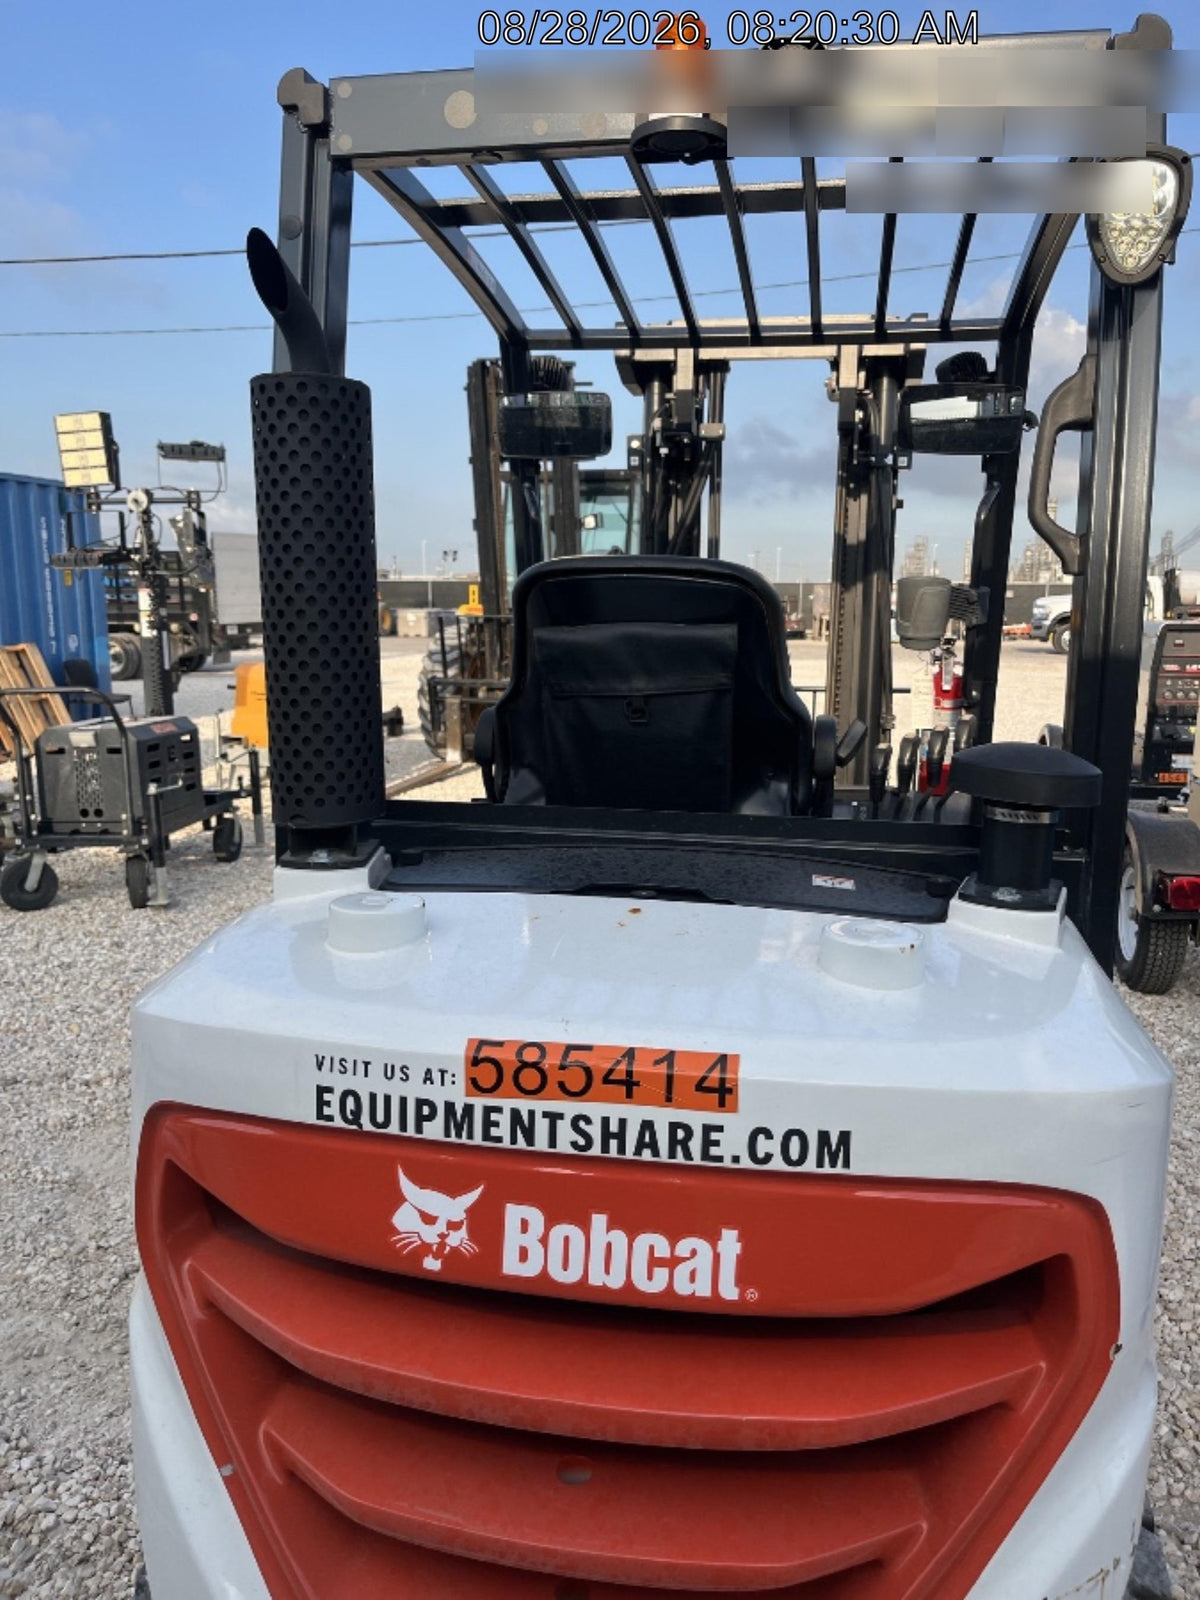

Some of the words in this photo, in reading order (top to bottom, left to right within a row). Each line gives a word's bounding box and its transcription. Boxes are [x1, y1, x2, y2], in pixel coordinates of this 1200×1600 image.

[315, 1054, 372, 1078] VISIT
[384, 1063, 410, 1082] US
[423, 1068, 456, 1086] AT:
[469, 1039, 733, 1108] 585414
[315, 1085, 852, 1170] EQUIPMENTSHARE.COM
[502, 1203, 742, 1301] Bobcat
